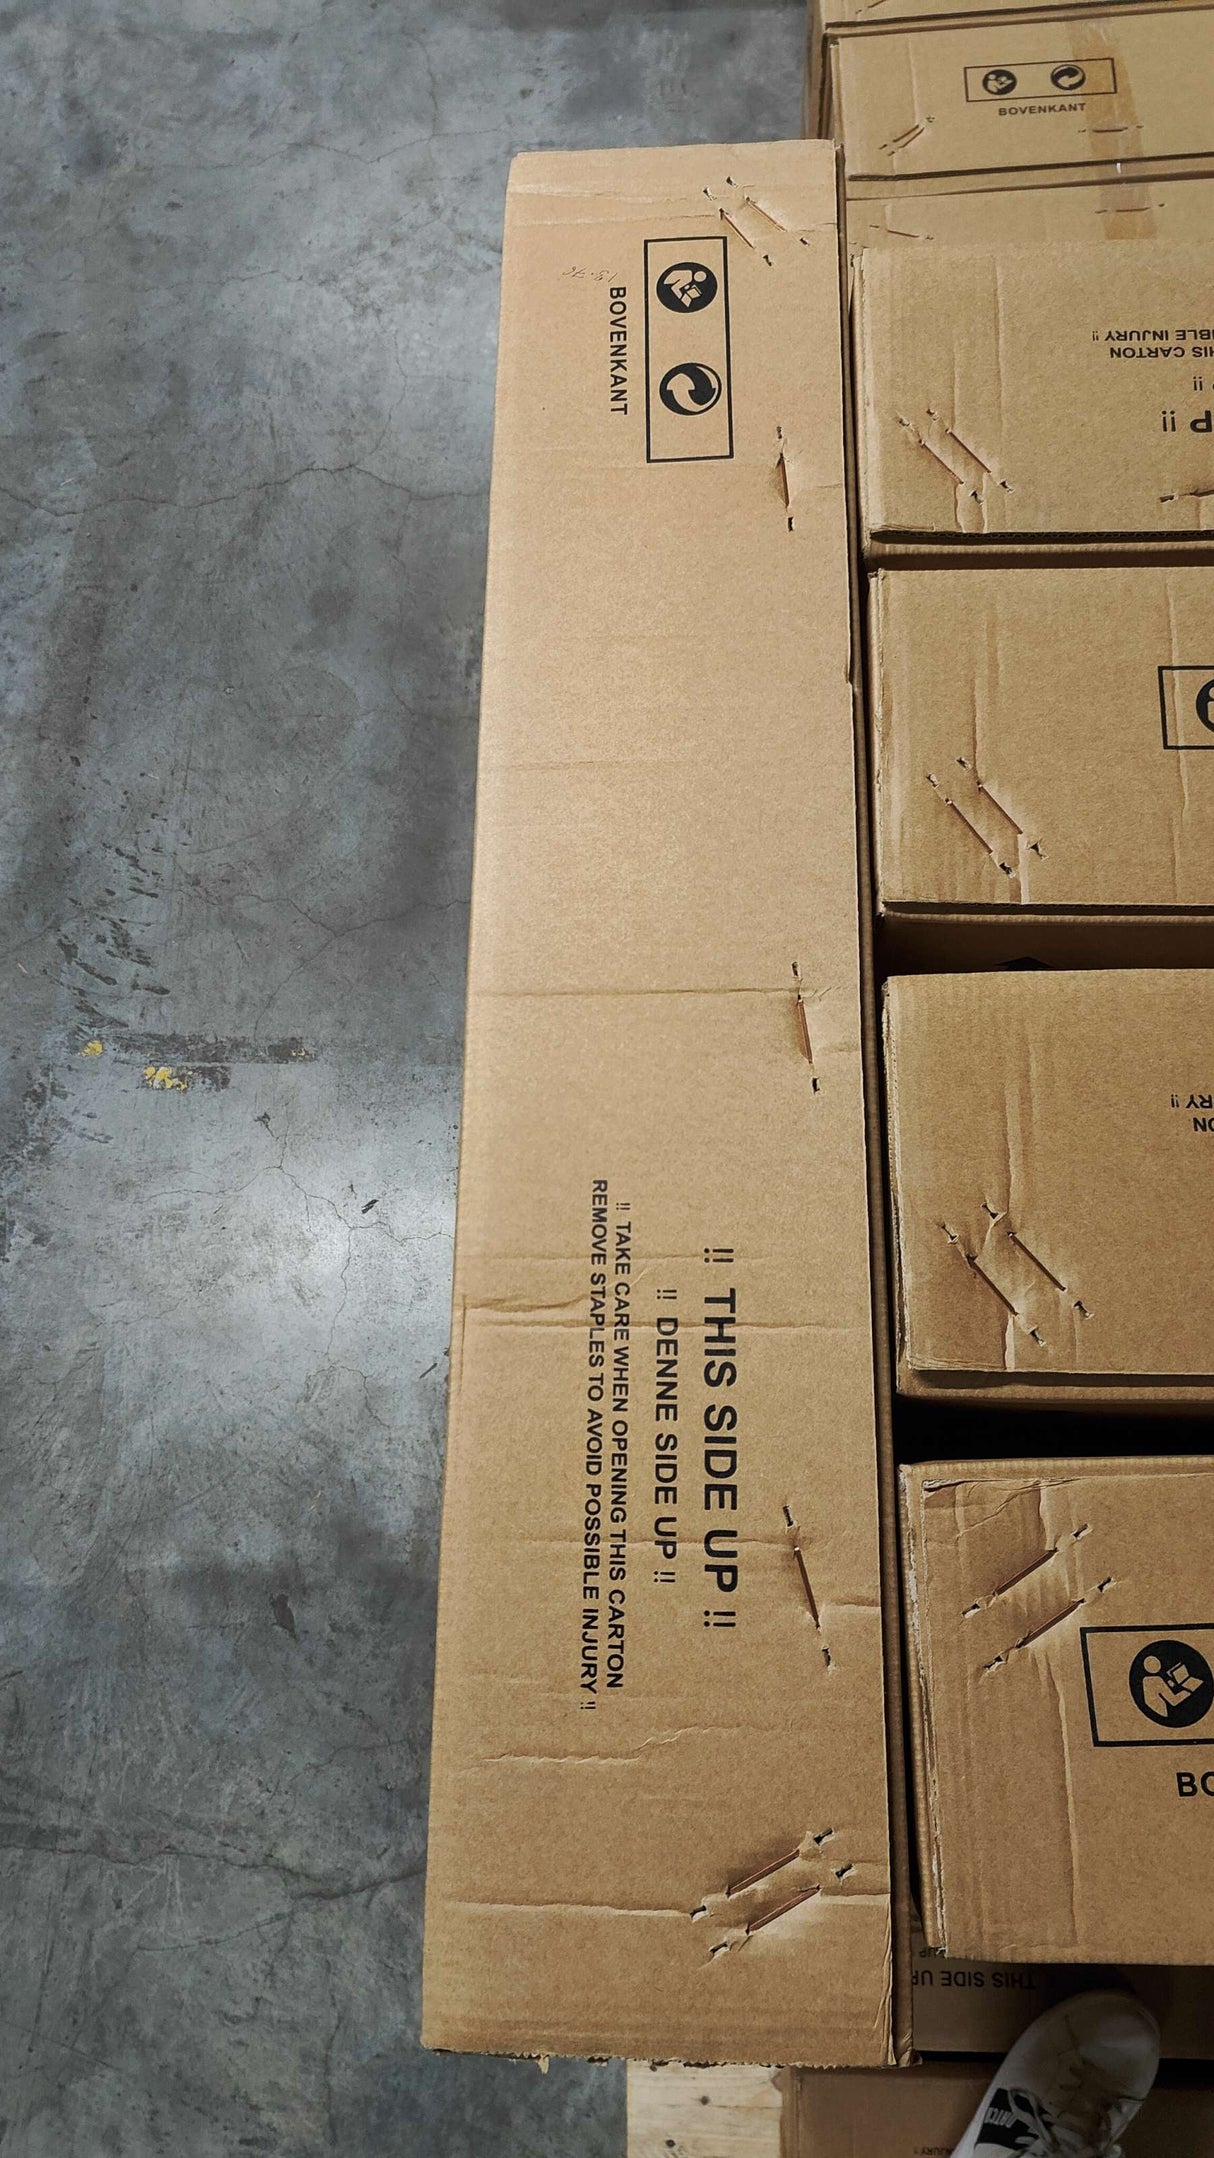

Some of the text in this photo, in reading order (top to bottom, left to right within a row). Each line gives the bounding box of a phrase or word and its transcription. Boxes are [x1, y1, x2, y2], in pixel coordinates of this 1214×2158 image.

[998, 103, 1086, 116] BOVENKANT
[1105, 329, 1168, 341] INJURY
[609, 286, 628, 415] BOVENKANT
[1110, 346, 1185, 358] CARTON
[1161, 410, 1213, 433] P !!
[580, 1179, 608, 1710] REMOVE STAPLES TO AVOID POSSIBLE INJURY !!
[607, 1202, 631, 1688] !! TAKE CARE WHEN OPENING THIS CARTON
[653, 1289, 678, 1583] !! DENNE SIDE UP !!
[703, 1248, 738, 1627] !! THIS SIDE UP !!
[940, 1970, 985, 1988] SIDE
[991, 1971, 1036, 1990] THIS
